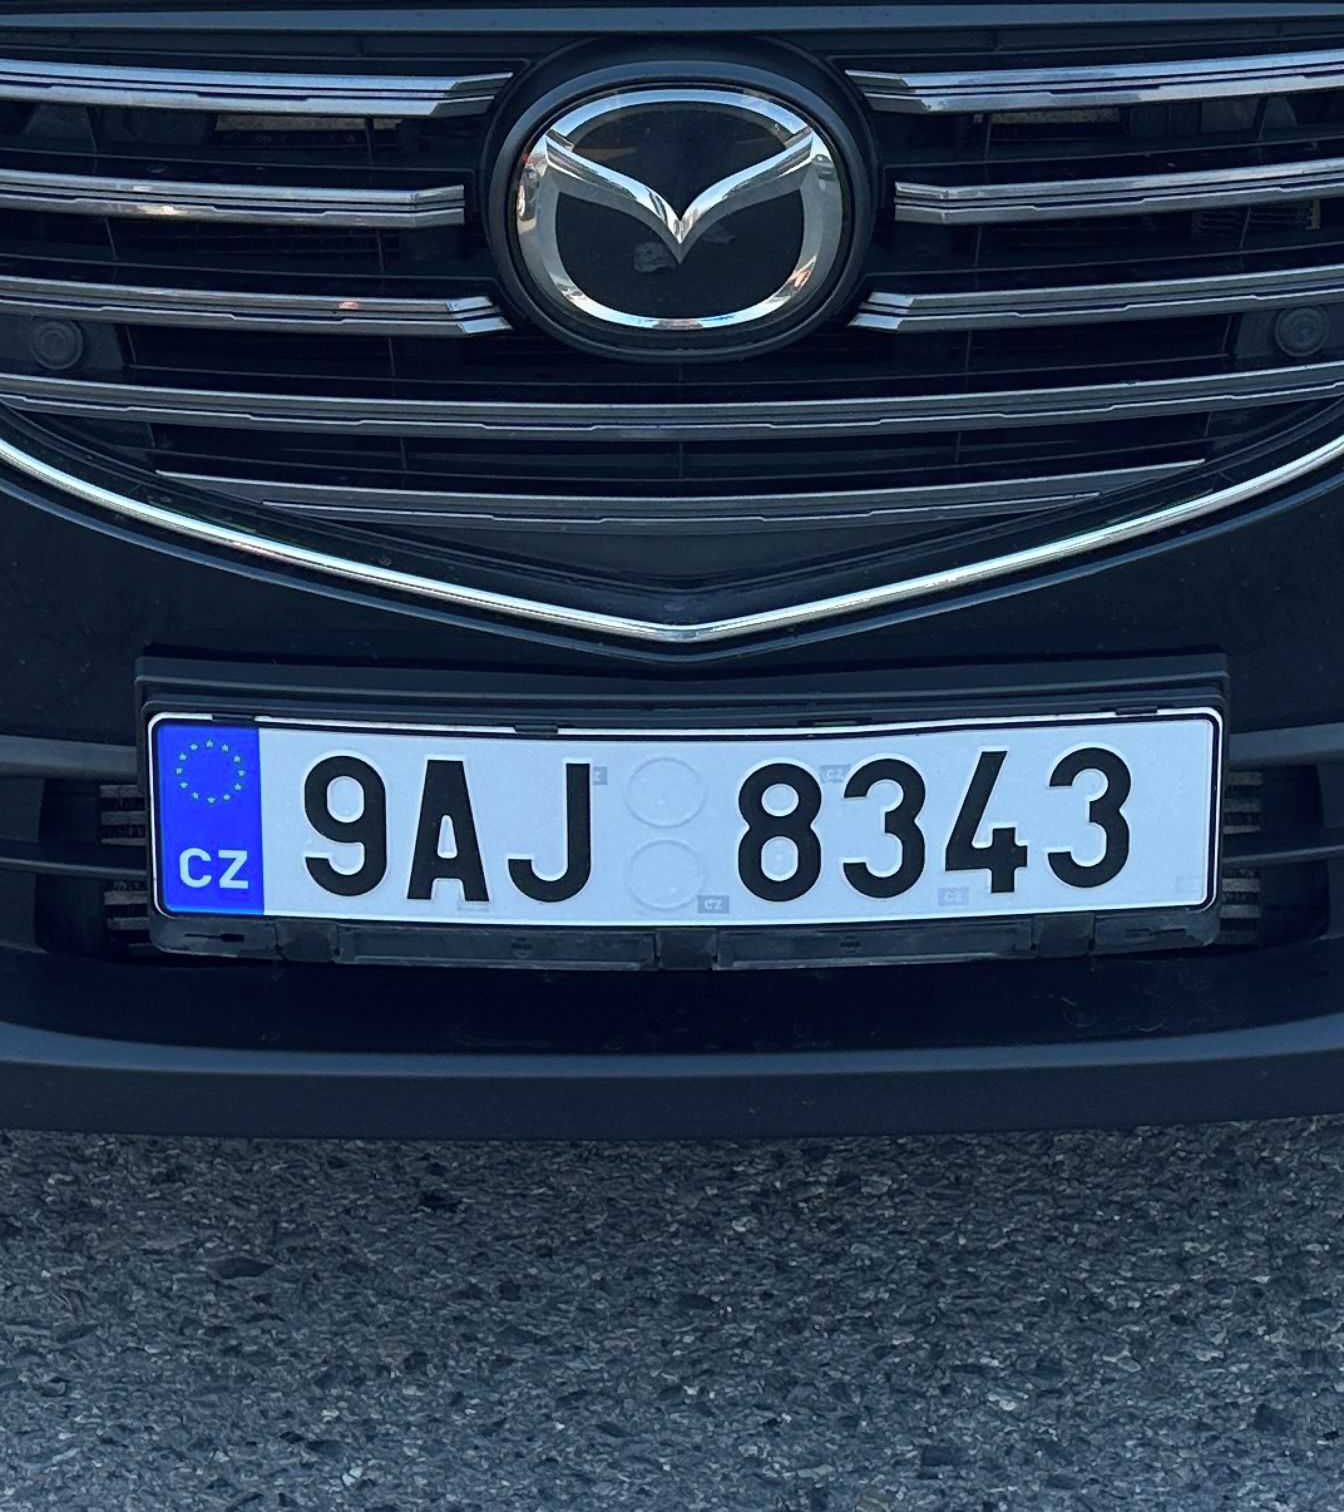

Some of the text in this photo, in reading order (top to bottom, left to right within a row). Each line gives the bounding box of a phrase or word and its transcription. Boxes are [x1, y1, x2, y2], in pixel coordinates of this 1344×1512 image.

[179, 746, 1131, 903] CZ 9AJ 8343
